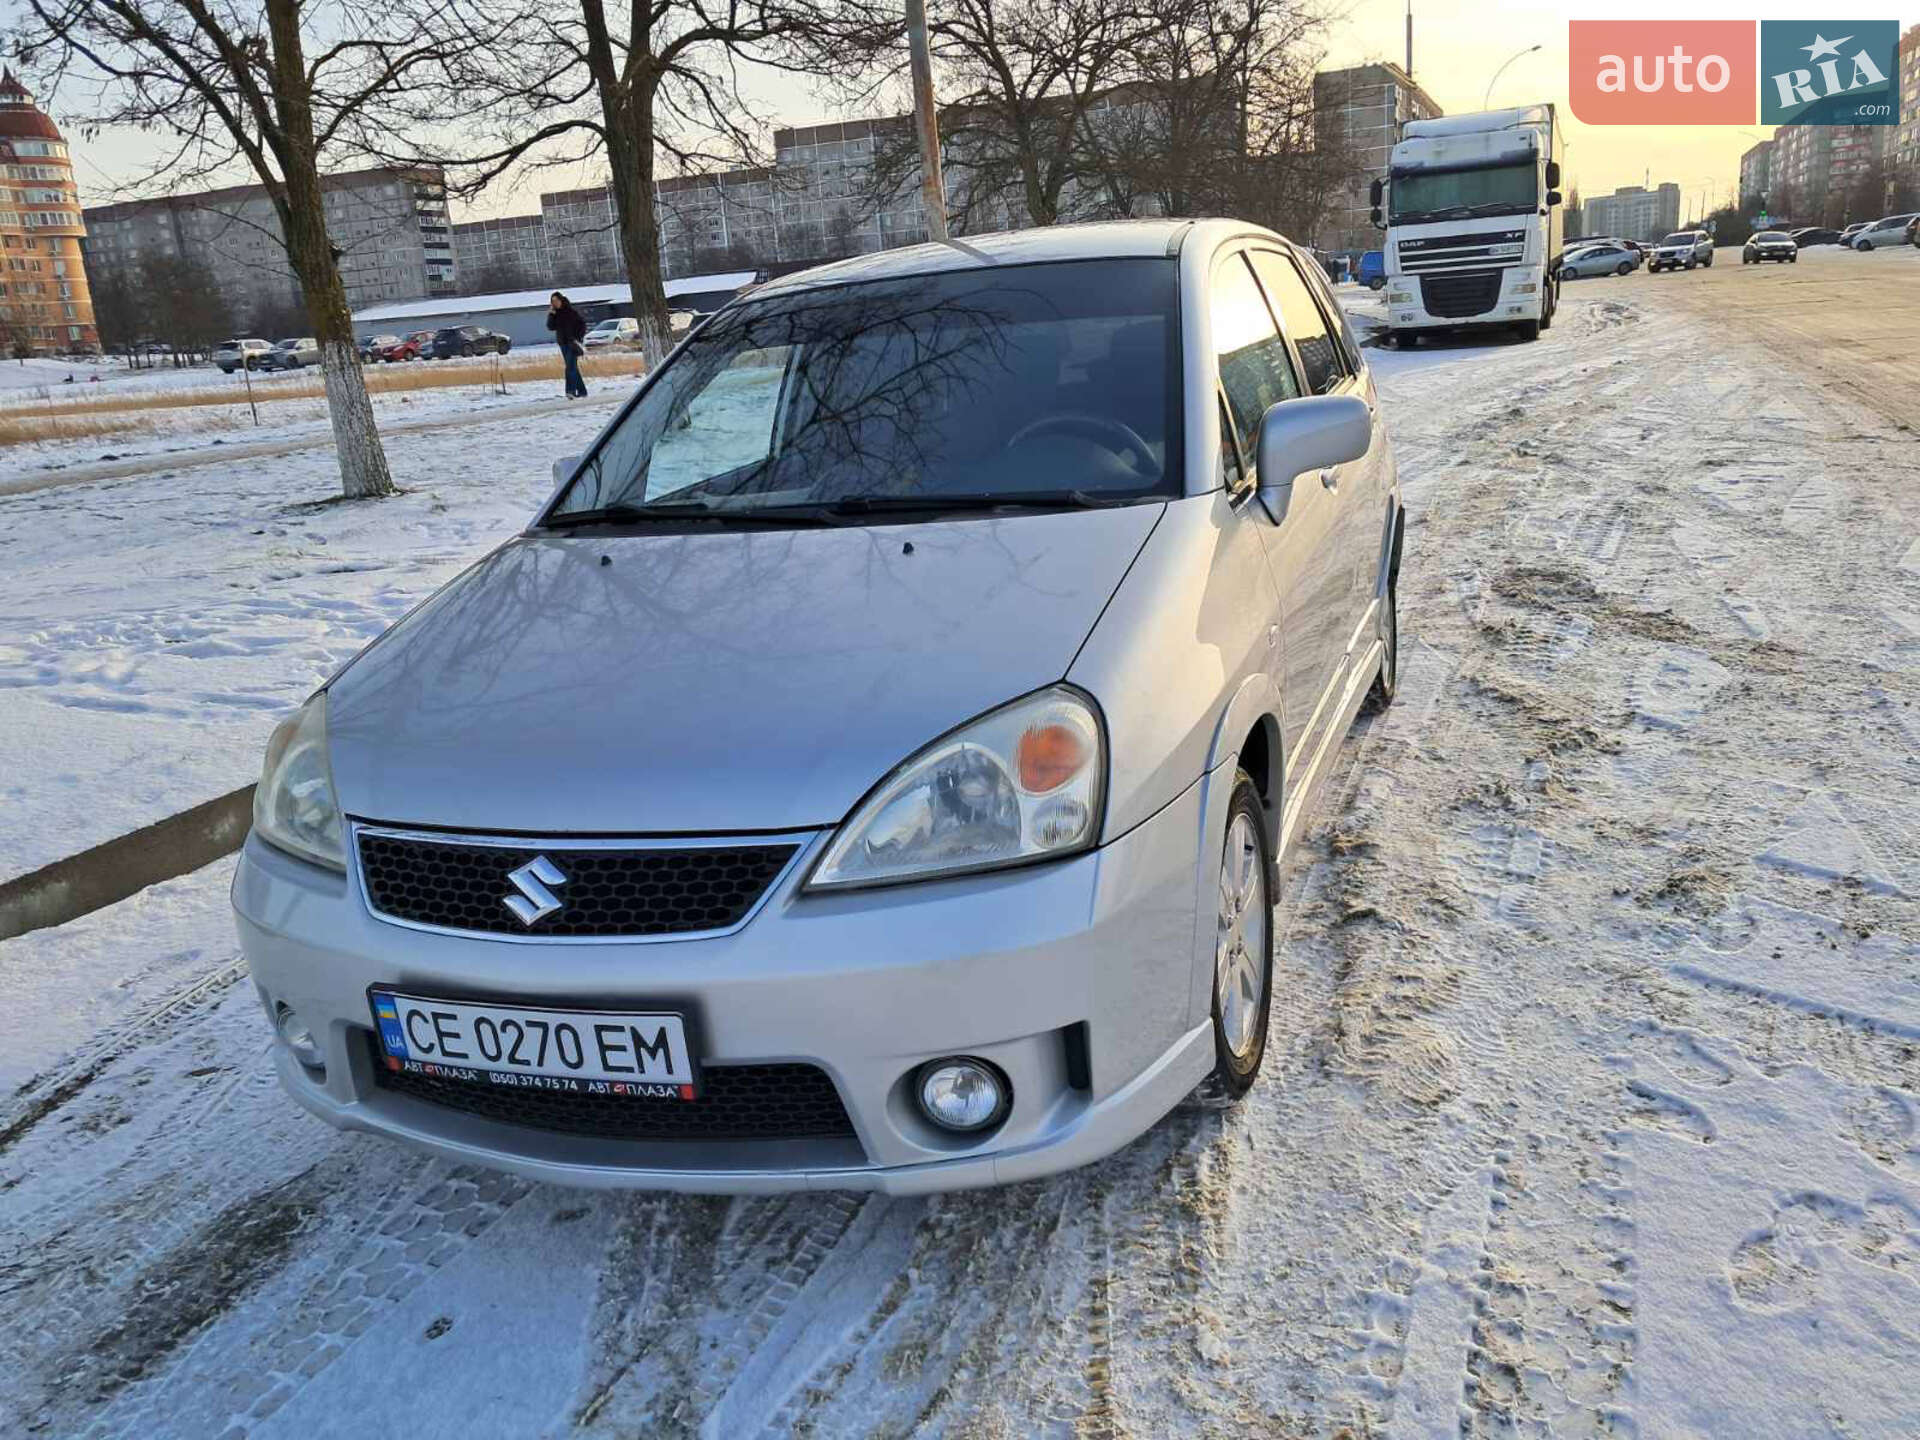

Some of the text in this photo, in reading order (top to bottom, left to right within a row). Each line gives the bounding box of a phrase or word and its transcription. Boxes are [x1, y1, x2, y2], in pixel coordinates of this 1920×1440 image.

[1400, 231, 1524, 248] DAF XF
[384, 1035, 405, 1049] UA
[406, 1009, 673, 1075] CE 0270 EM
[489, 1072, 517, 1086] (050)
[519, 1075, 542, 1088] 374
